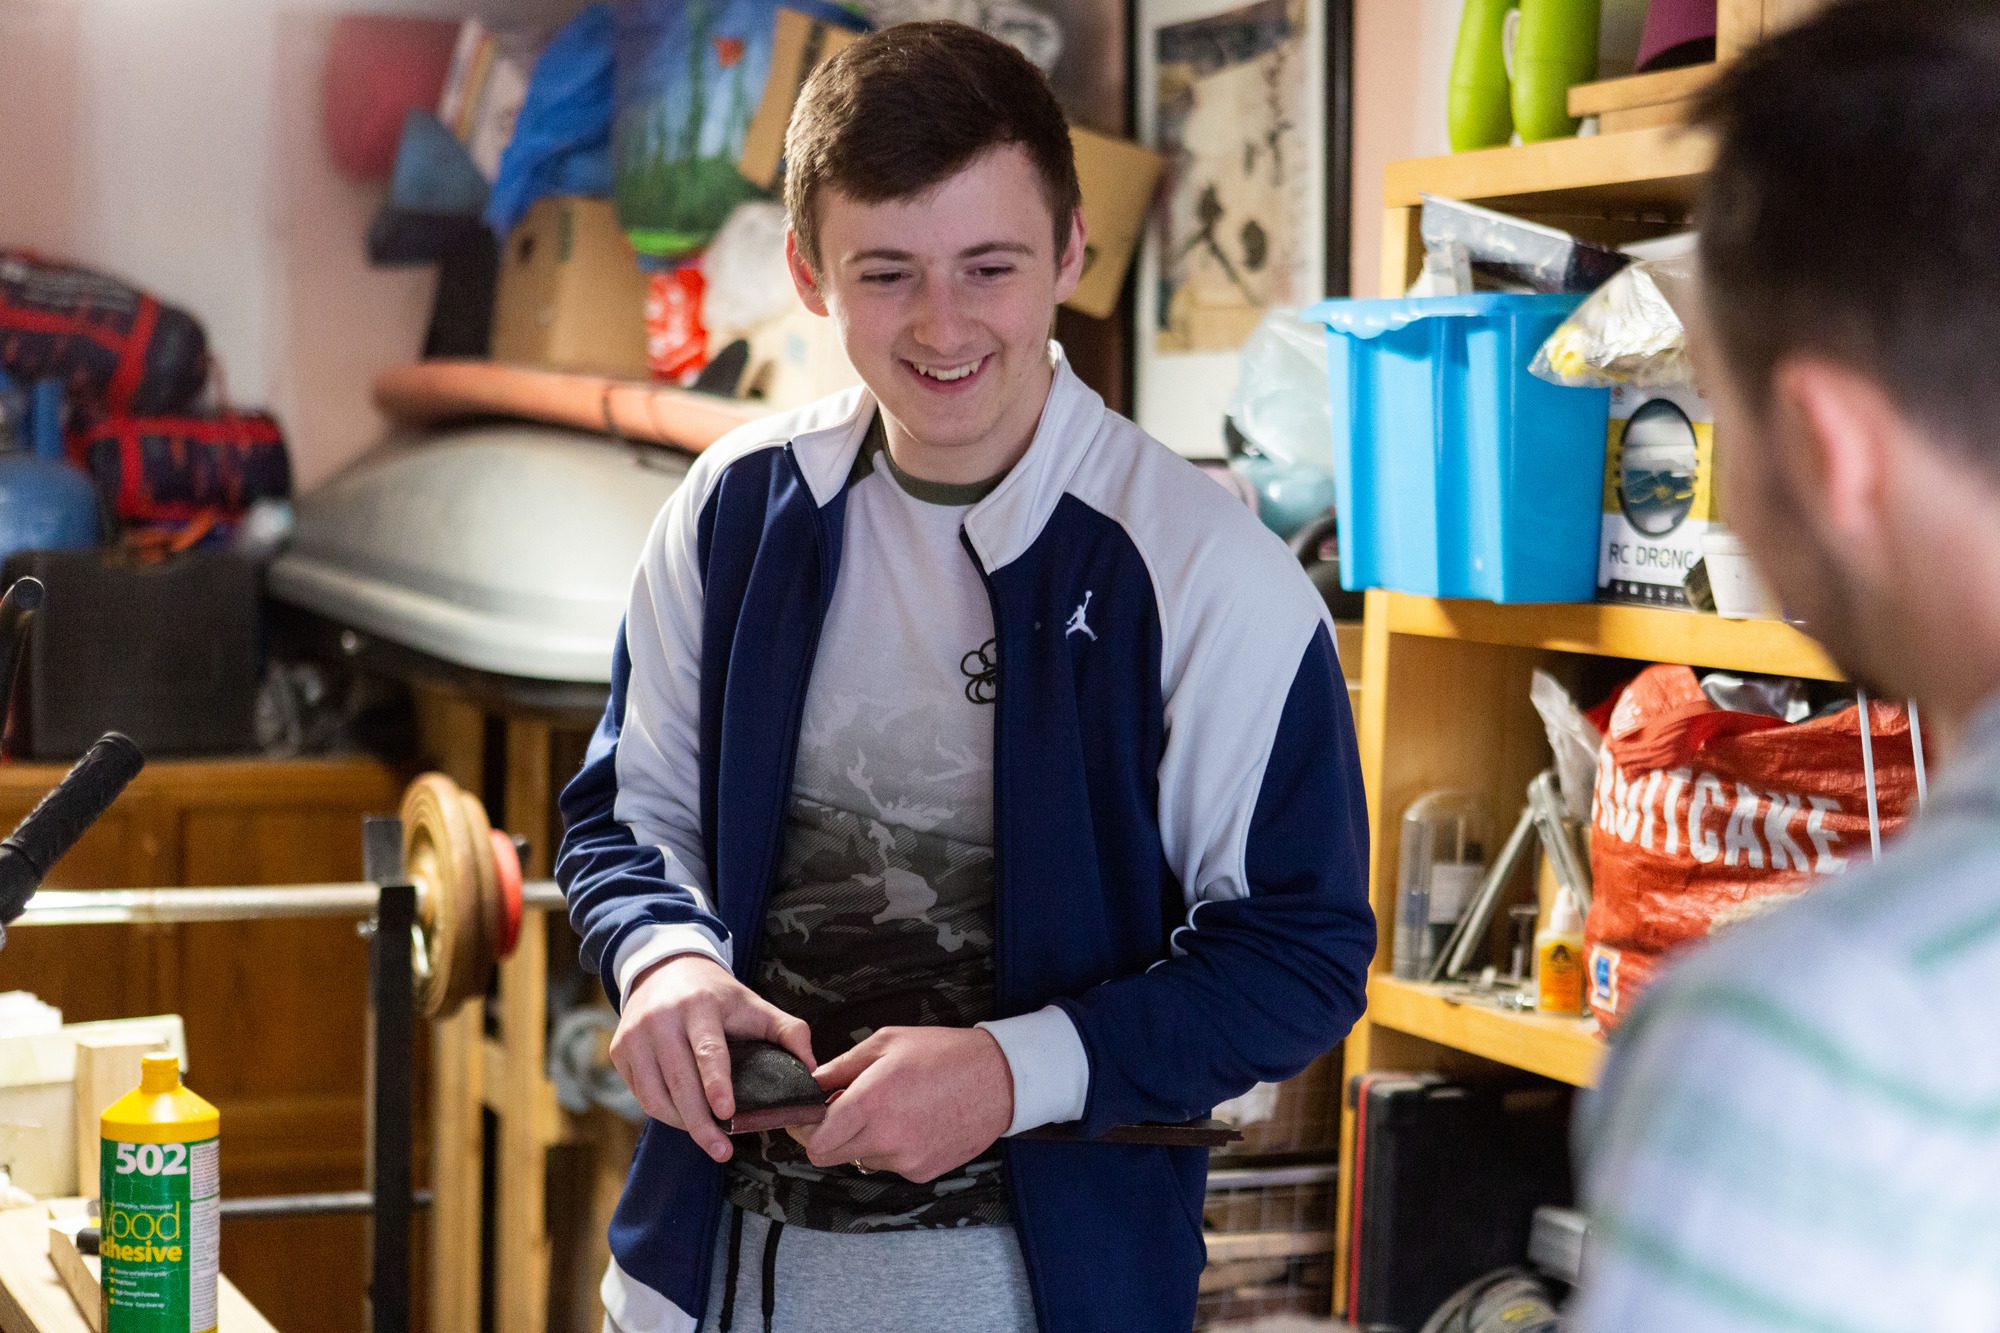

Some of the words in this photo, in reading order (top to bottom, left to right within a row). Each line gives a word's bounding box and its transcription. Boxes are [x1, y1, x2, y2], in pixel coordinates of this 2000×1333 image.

[1608, 543, 1629, 565] RC
[115, 1142, 188, 1177] 502
[99, 1236, 182, 1262] dhesive
